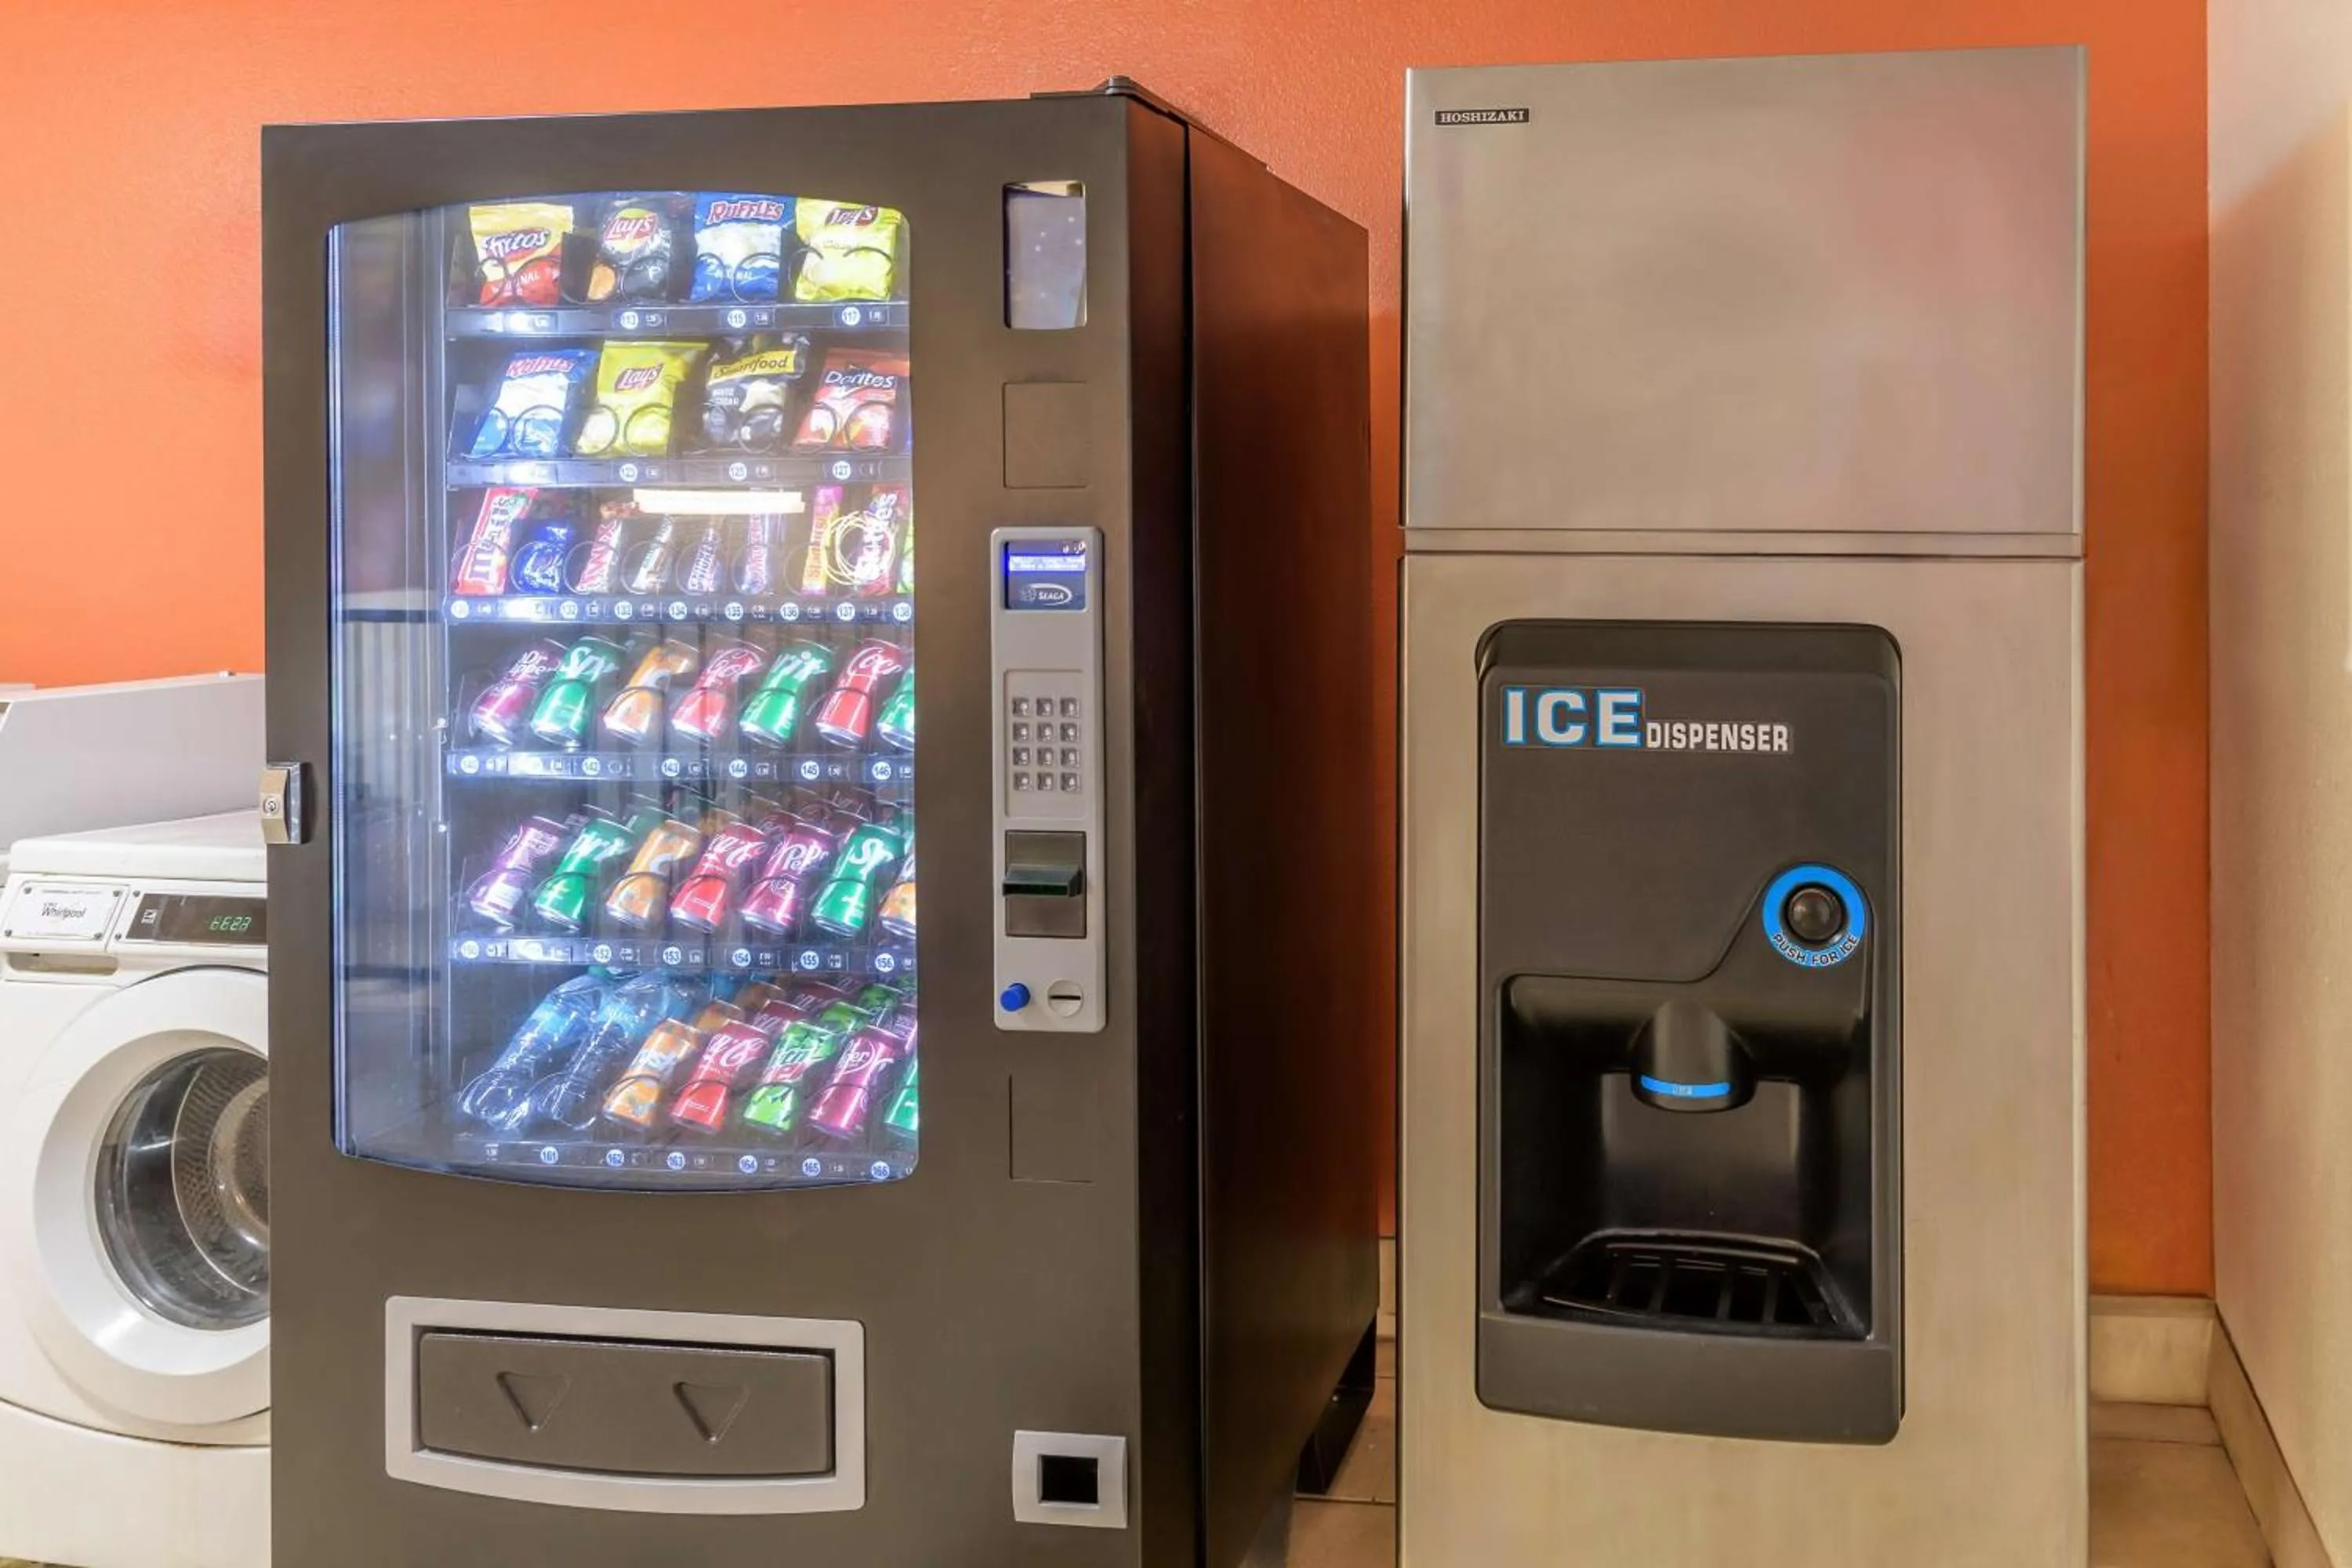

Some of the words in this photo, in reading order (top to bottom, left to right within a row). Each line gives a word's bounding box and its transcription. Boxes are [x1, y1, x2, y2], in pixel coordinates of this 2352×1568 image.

[1440, 111, 1525, 123] HOSHIZAKI
[826, 371, 895, 388] Doritos
[1037, 590, 1065, 601] SEAGA
[1504, 688, 1641, 747] ICE
[1646, 722, 1789, 752] DISPENSER
[1773, 931, 1807, 964] PUSH
[1811, 951, 1838, 966] FOR
[1839, 933, 1860, 954] ICE
